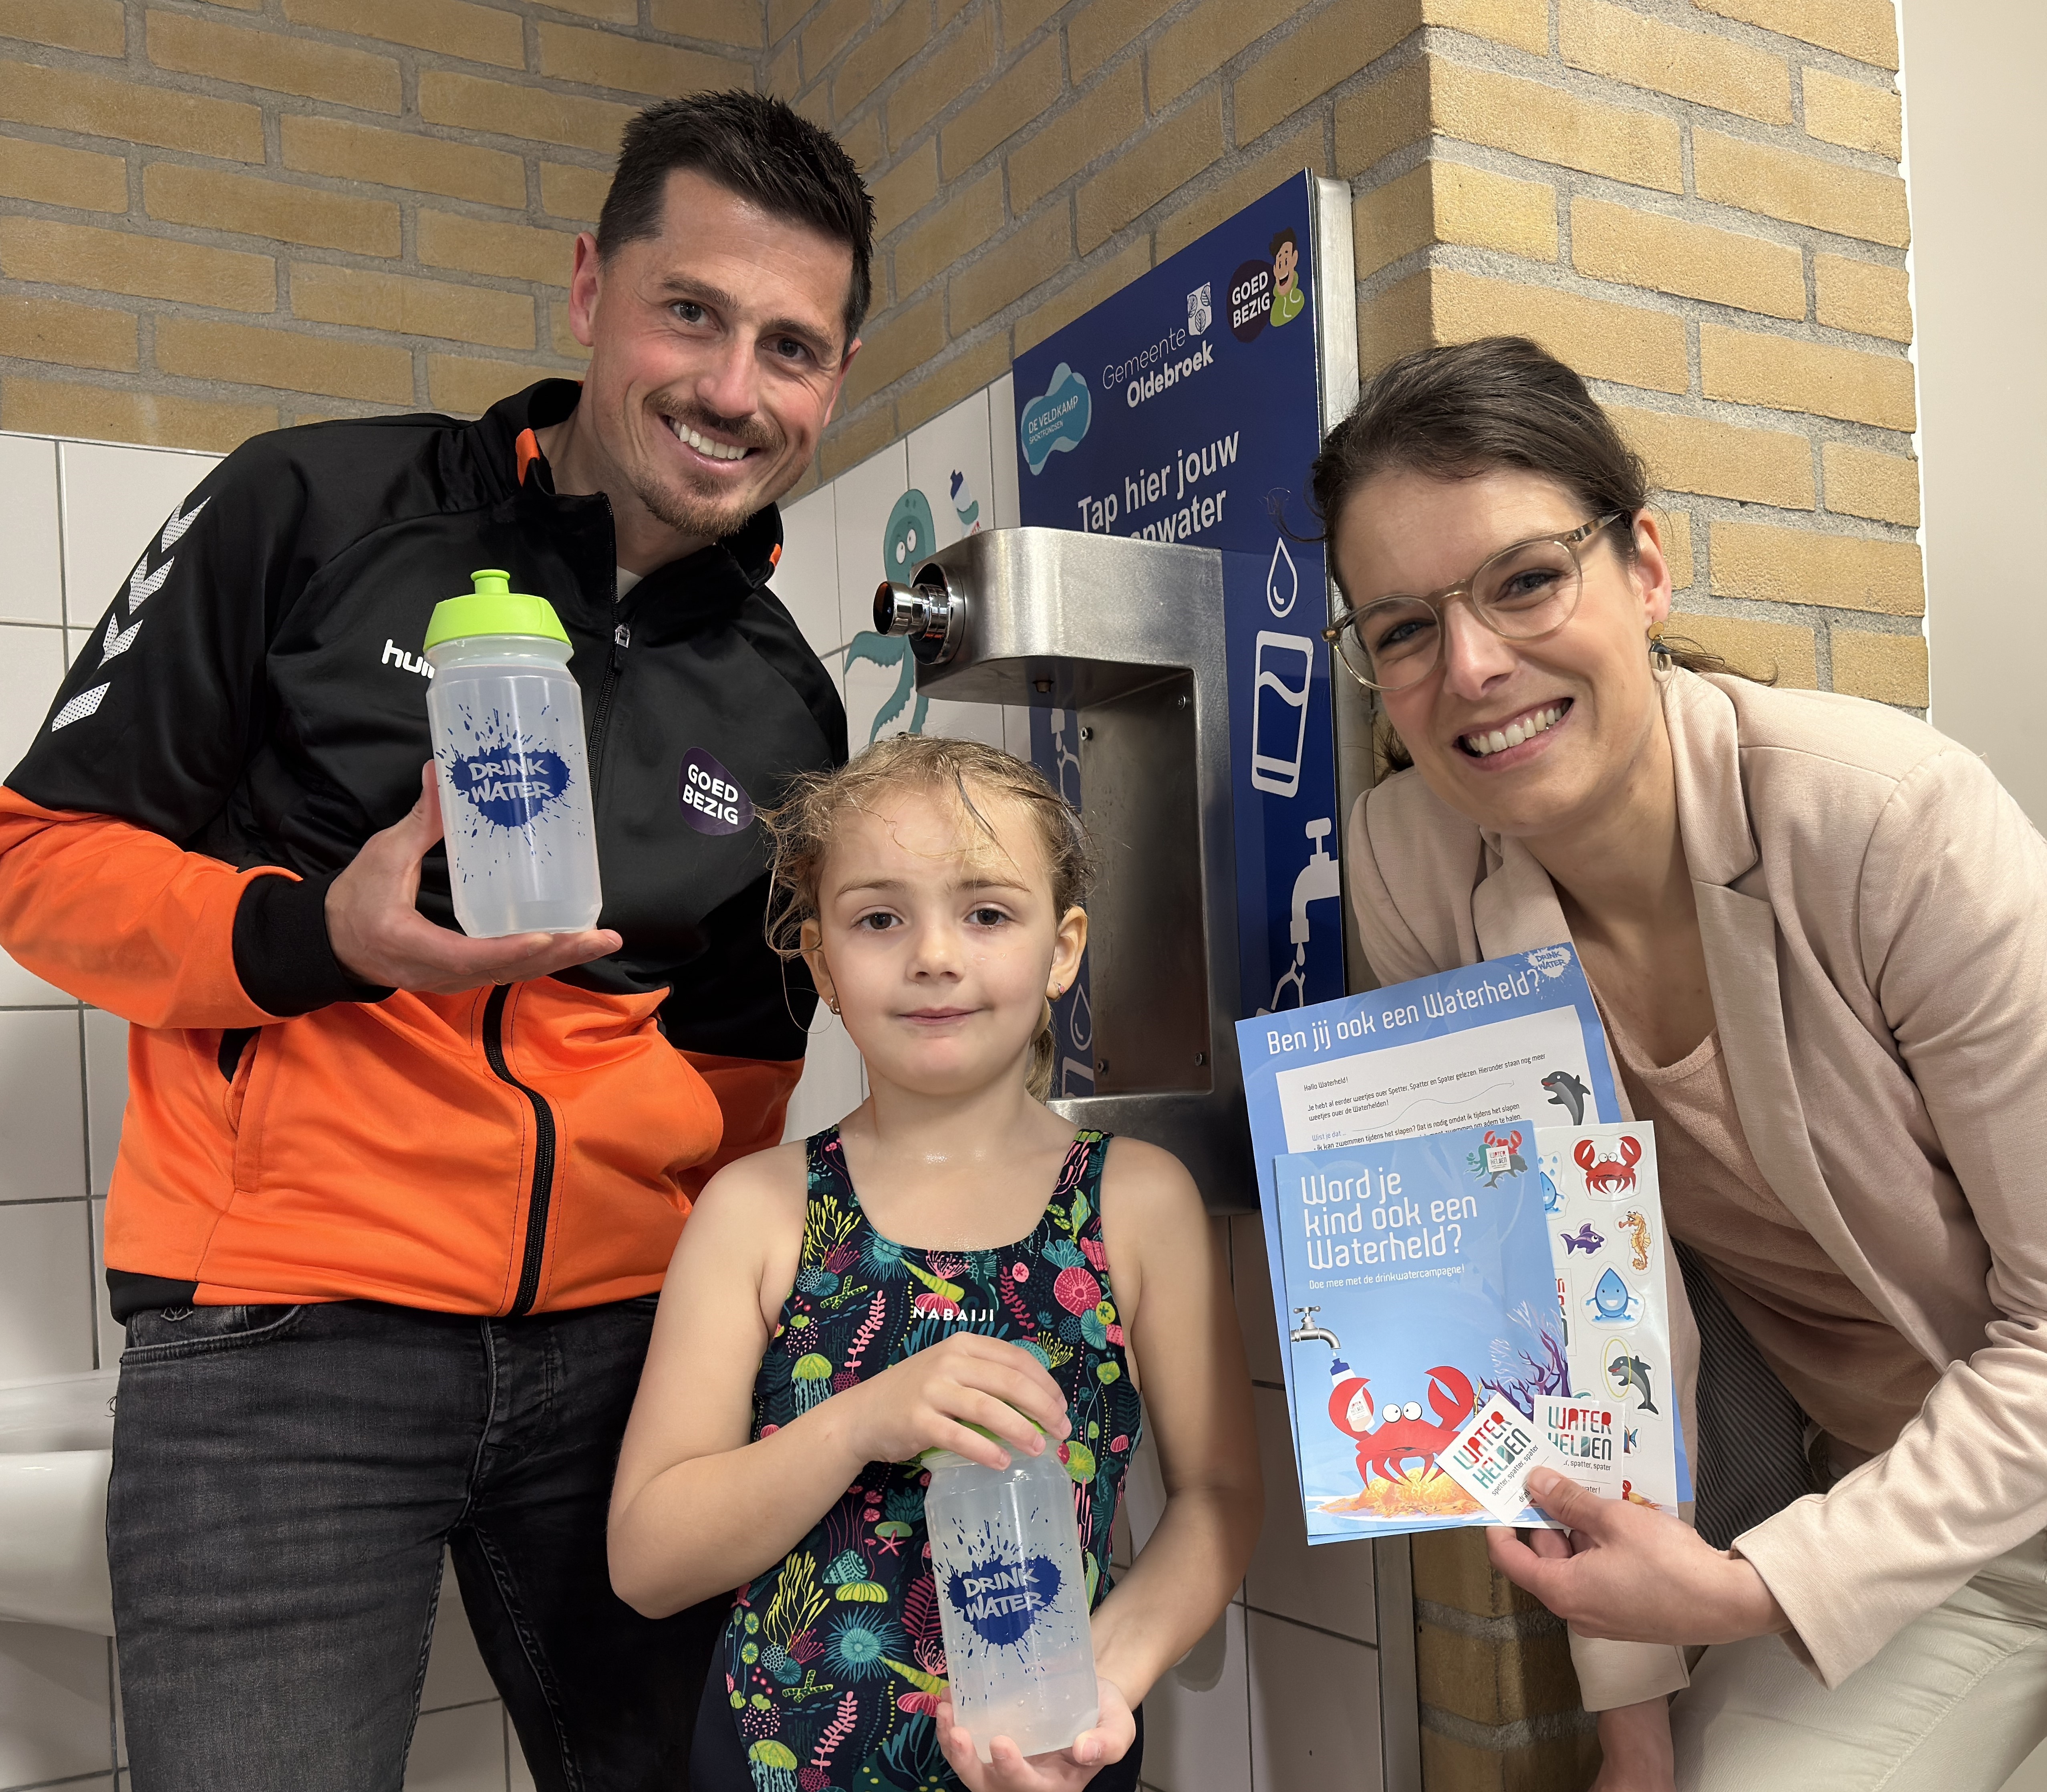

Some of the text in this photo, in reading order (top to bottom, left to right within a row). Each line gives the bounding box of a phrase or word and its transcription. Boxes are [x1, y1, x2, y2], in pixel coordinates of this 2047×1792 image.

[1232, 272, 1268, 305] GOED
[1233, 292, 1270, 328] BEZIG
[1103, 328, 1185, 389] Gemeente
[1127, 340, 1213, 407] Oldebroek
[1029, 395, 1078, 434] DE VELDKAMP
[1078, 431, 1239, 533] Tap hier jouw
[468, 757, 549, 781] DRINK
[687, 763, 739, 802] GOED
[471, 780, 555, 804] WATER
[682, 784, 739, 825] BEZIG
[1535, 951, 1562, 962] DRINK
[1538, 959, 1566, 970] WATER
[1267, 969, 1539, 1055] Ben jij ook een Waterheld?
[1318, 1076, 1348, 1089] Waterheld!
[1335, 1097, 1352, 1106] eerder
[1353, 1093, 1374, 1103] weetjes
[1388, 1086, 1409, 1095] Spetter,
[1410, 1080, 1429, 1091] Spatter
[1437, 1075, 1455, 1084] Spater
[1505, 1060, 1520, 1068] staan
[1309, 1112, 1331, 1121] weetjes
[1353, 1100, 1389, 1113] Waterhelden!
[1336, 1138, 1364, 1147] zwemmen
[1365, 1133, 1384, 1142] tijdens
[1395, 1125, 1416, 1136] slapen?
[1433, 1119, 1448, 1127] nodig
[1449, 1116, 1466, 1124] omdat
[1473, 1111, 1491, 1120] tijdens
[1502, 1104, 1519, 1113] slapen
[1483, 1119, 1498, 1127] adem
[1505, 1114, 1522, 1122] halen.
[1301, 1167, 1402, 1205] Word je
[1304, 1196, 1477, 1238] kind ook een
[1307, 1224, 1461, 1270] Waterheld?
[1310, 1264, 1465, 1289] Doe mee met de drinkwatercampagne!
[913, 1306, 994, 1322] NABAIJI
[1548, 1406, 1612, 1435] WATER
[1453, 1411, 1512, 1470] WATER
[1472, 1428, 1531, 1489] HELDEN
[1548, 1433, 1612, 1461] HELDEN
[1492, 1445, 1539, 1496] spetter, spatter, spater
[1570, 1461, 1592, 1469] spatter,
[962, 1565, 1040, 1598] DRINK
[965, 1590, 1047, 1622] WATER
